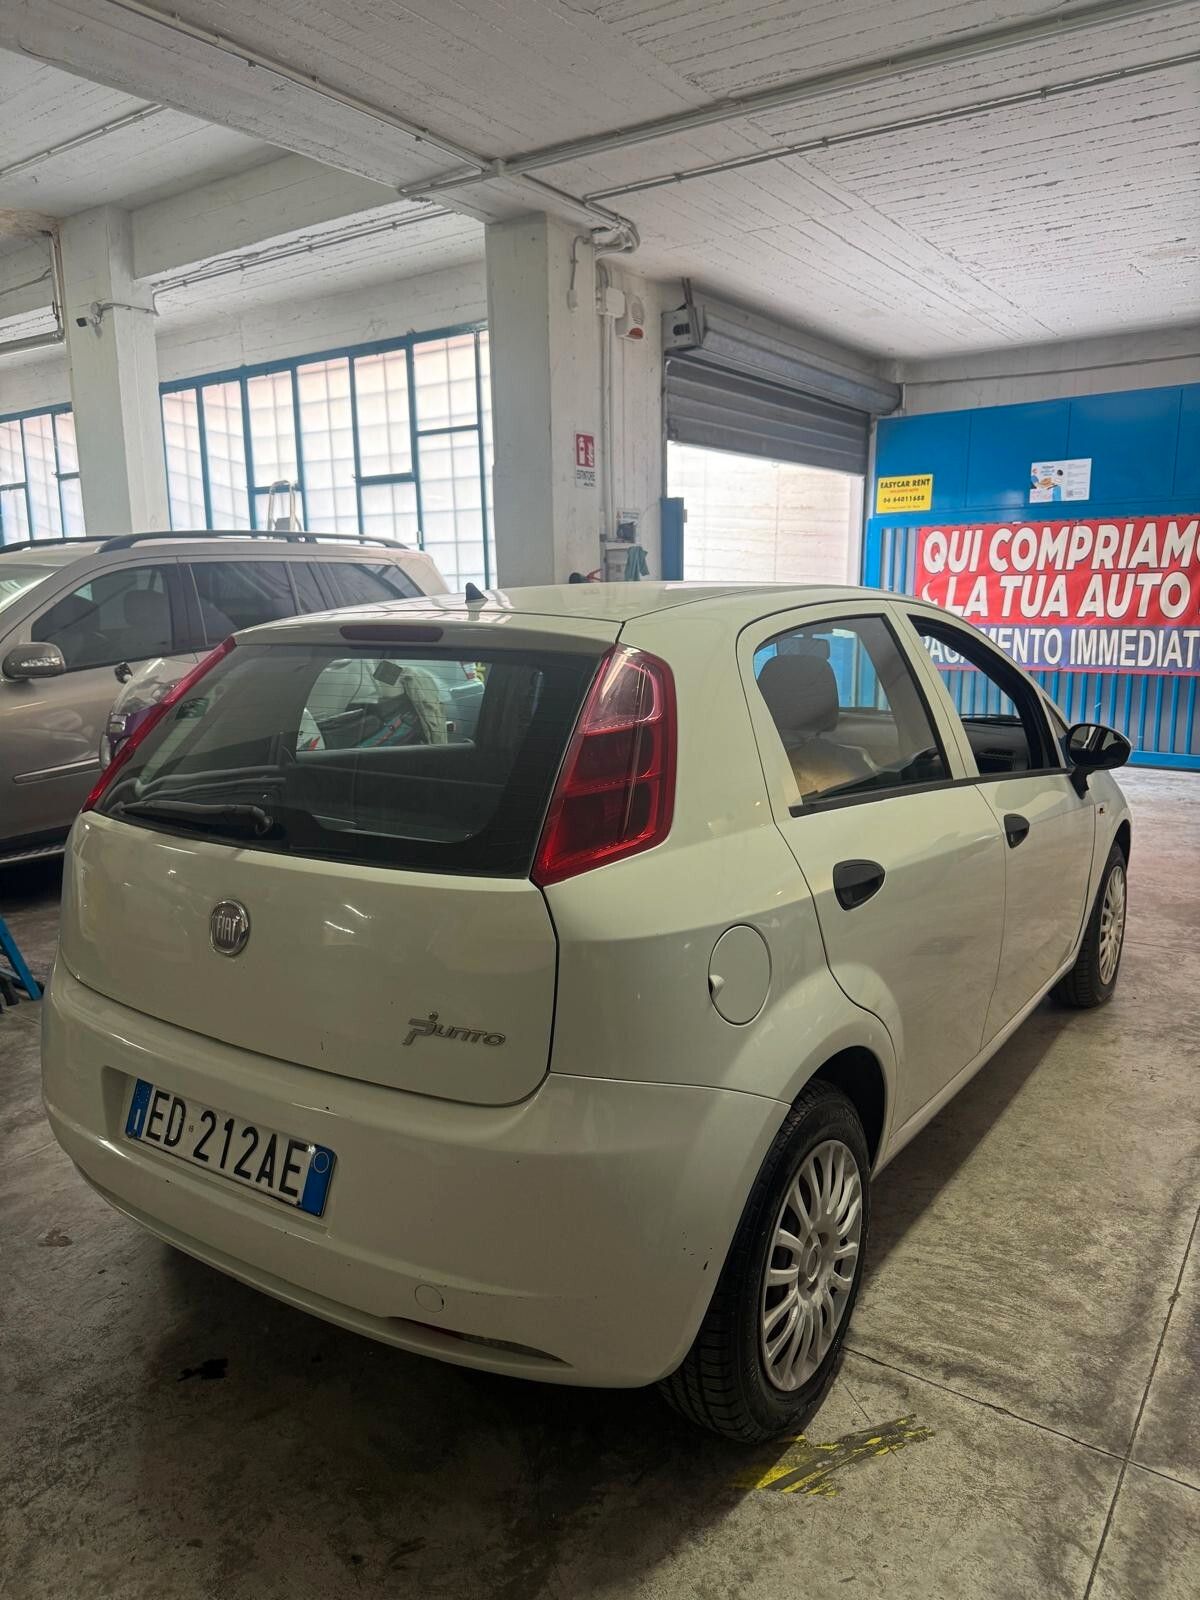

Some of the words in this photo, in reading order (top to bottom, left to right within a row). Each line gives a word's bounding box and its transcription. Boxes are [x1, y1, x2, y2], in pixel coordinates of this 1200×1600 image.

[880, 480, 910, 489] EASYCAR
[912, 478, 931, 487] RENT
[923, 530, 983, 573] QUI
[989, 520, 1200, 572] COMPRIAM
[945, 575, 988, 617] LA
[1000, 574, 1068, 618] TUA
[1076, 571, 1191, 618] AUTO
[1070, 628, 1200, 668] IMMEDIAT
[216, 915, 239, 941] FIAT
[146, 1090, 187, 1147] ED
[193, 1110, 308, 1197] 212AE
